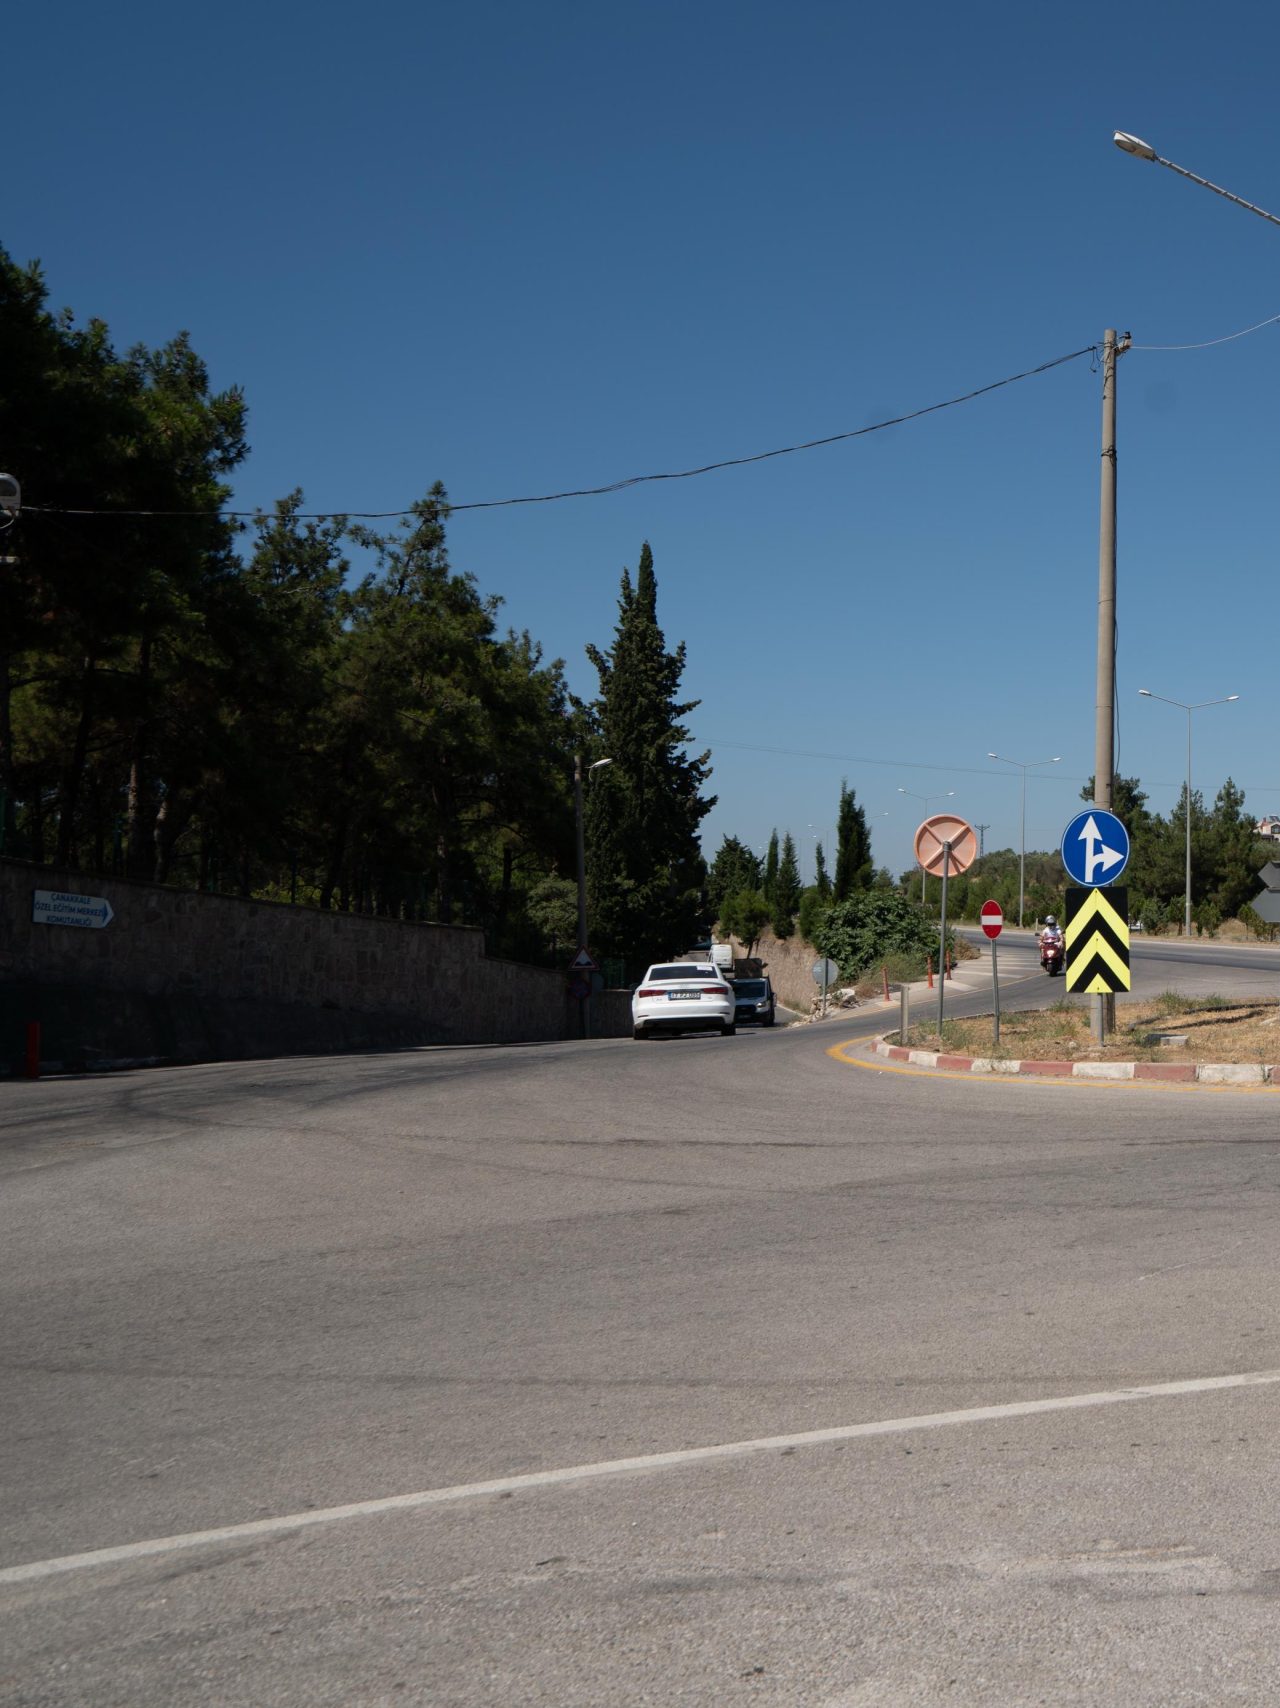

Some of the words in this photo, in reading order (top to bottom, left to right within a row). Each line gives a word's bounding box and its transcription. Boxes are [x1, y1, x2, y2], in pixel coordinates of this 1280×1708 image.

[51, 893, 92, 905] ÇANAKKALE
[35, 901, 52, 912] ÖZEL
[53, 902, 76, 914] EĞİTİM
[47, 915, 92, 927] KOMUTANLIĞI
